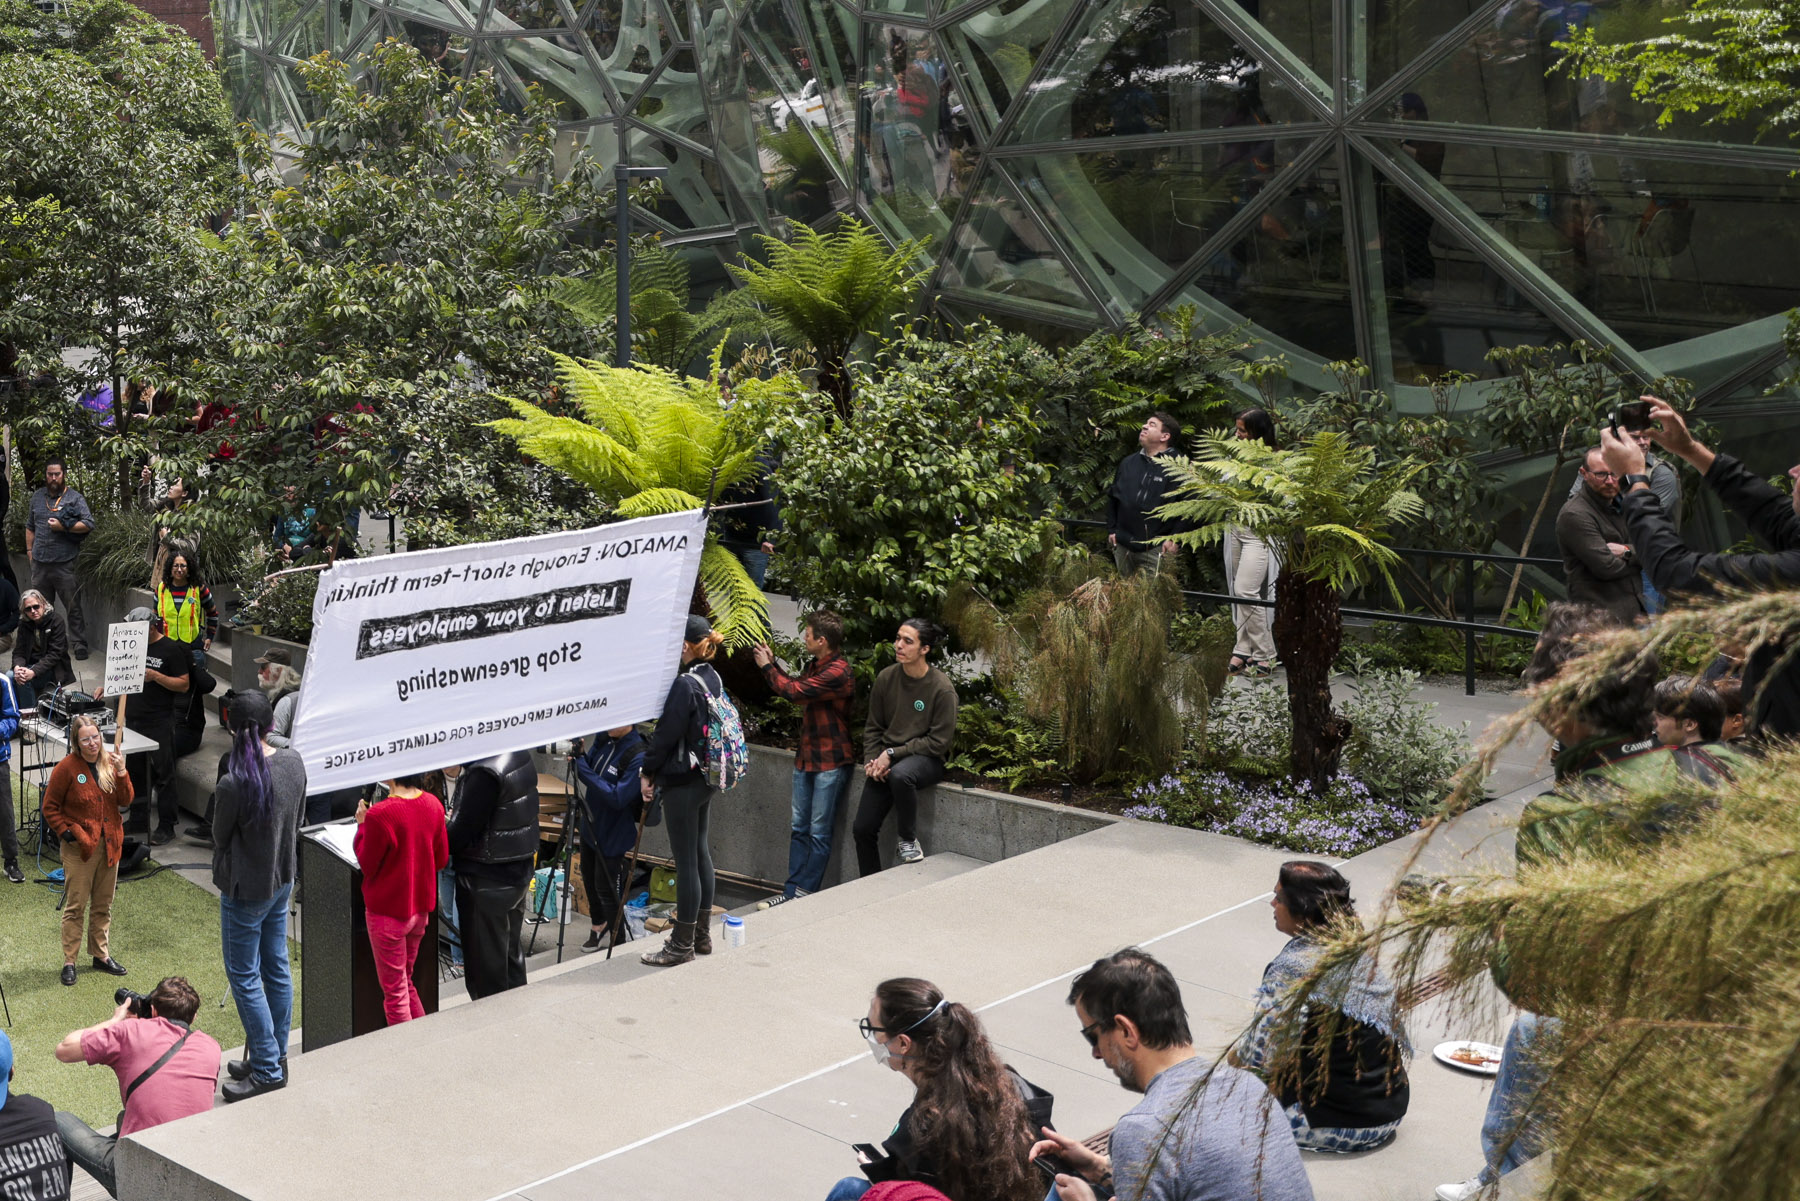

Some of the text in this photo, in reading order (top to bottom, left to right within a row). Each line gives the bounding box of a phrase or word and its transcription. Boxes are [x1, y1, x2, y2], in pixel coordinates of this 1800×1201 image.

[114, 640, 137, 651] RTO
[114, 665, 138, 673] impacts
[107, 684, 141, 695] CLIMATE
[1622, 739, 1653, 754] Canon
[41, 1166, 66, 1197] AN
